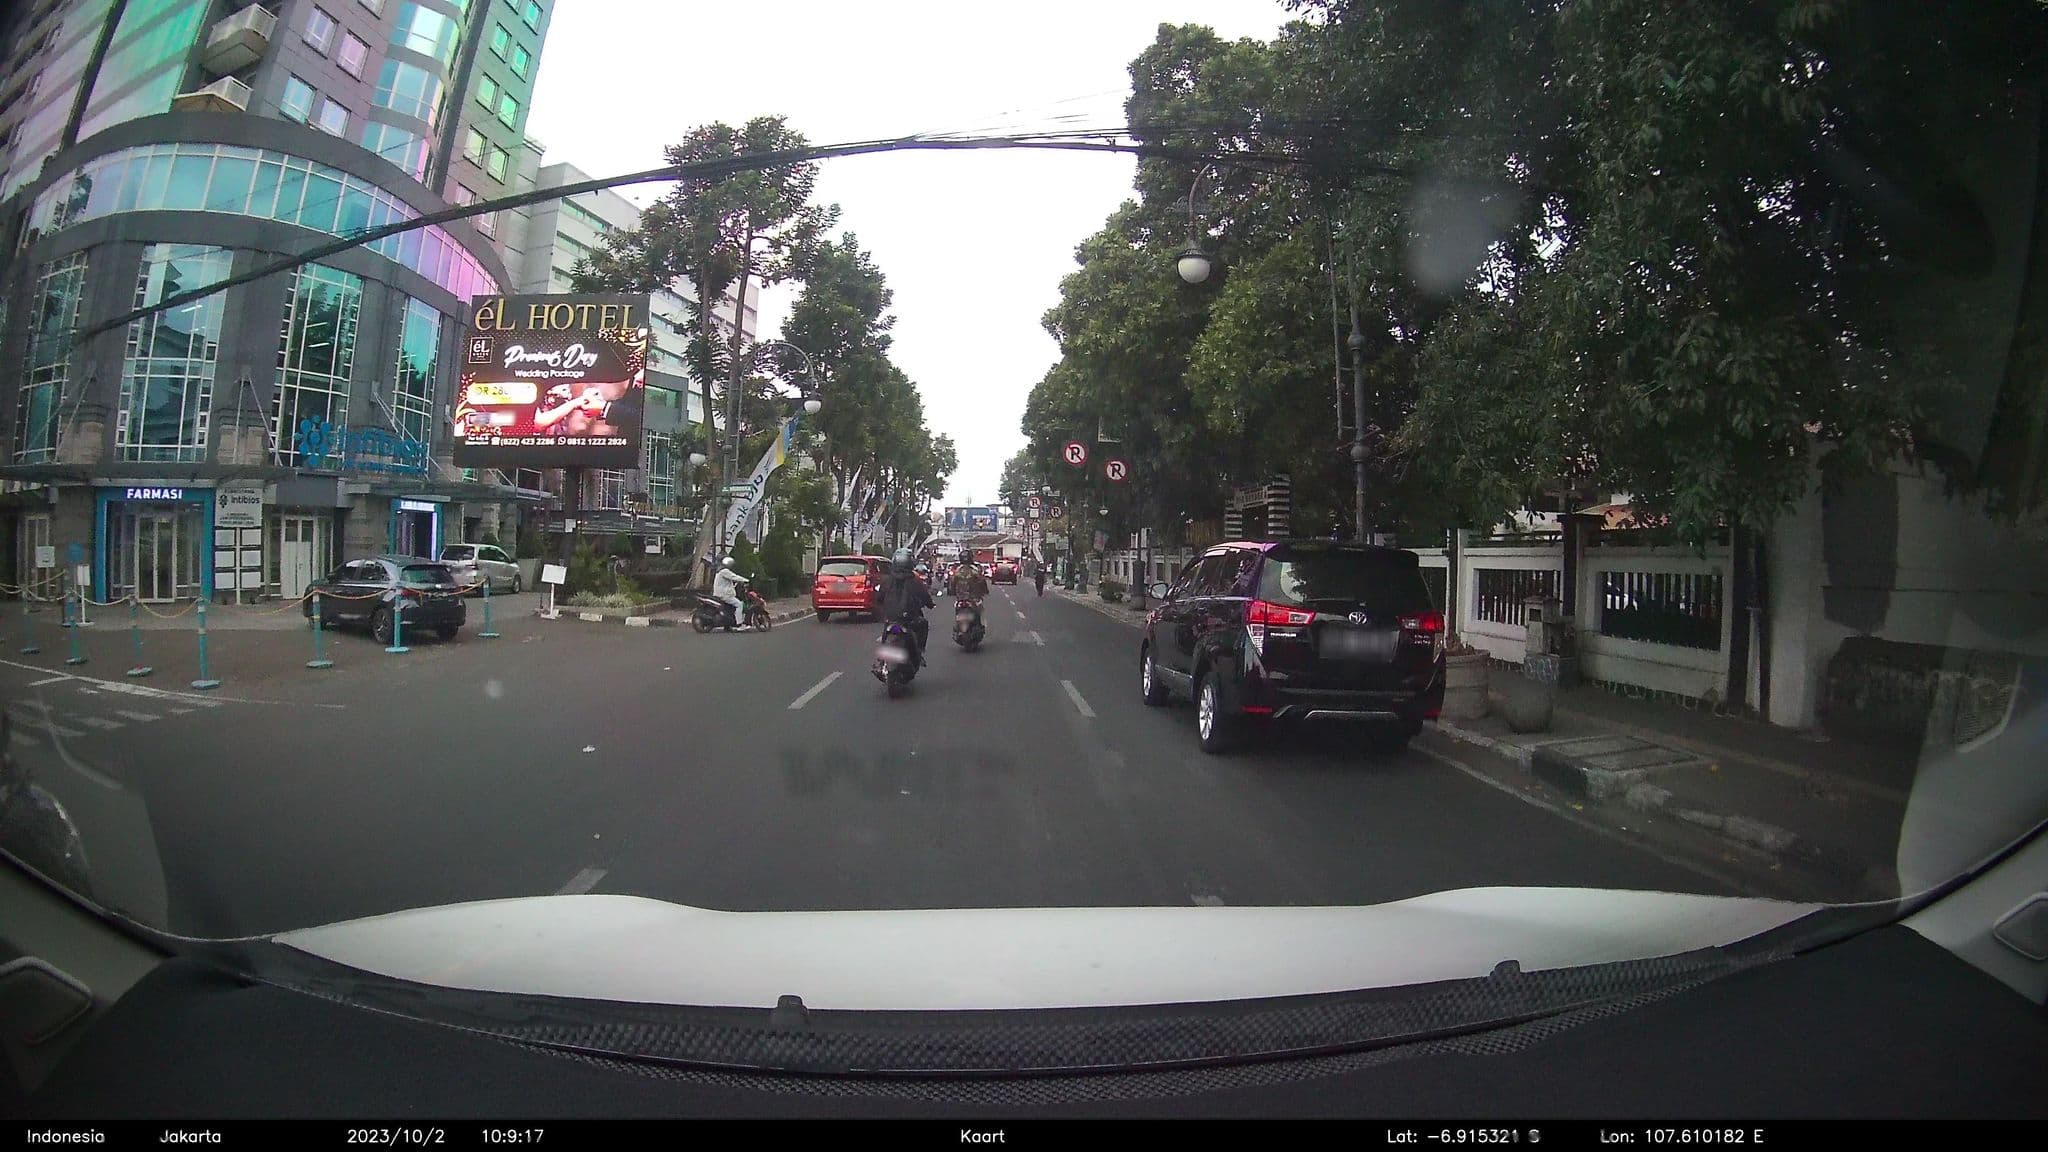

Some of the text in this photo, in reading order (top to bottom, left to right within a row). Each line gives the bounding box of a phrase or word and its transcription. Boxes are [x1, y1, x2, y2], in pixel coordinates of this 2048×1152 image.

[528, 303, 641, 331] HOTEL
[514, 370, 585, 379] Wedding Package
[127, 488, 183, 500] FARMASI
